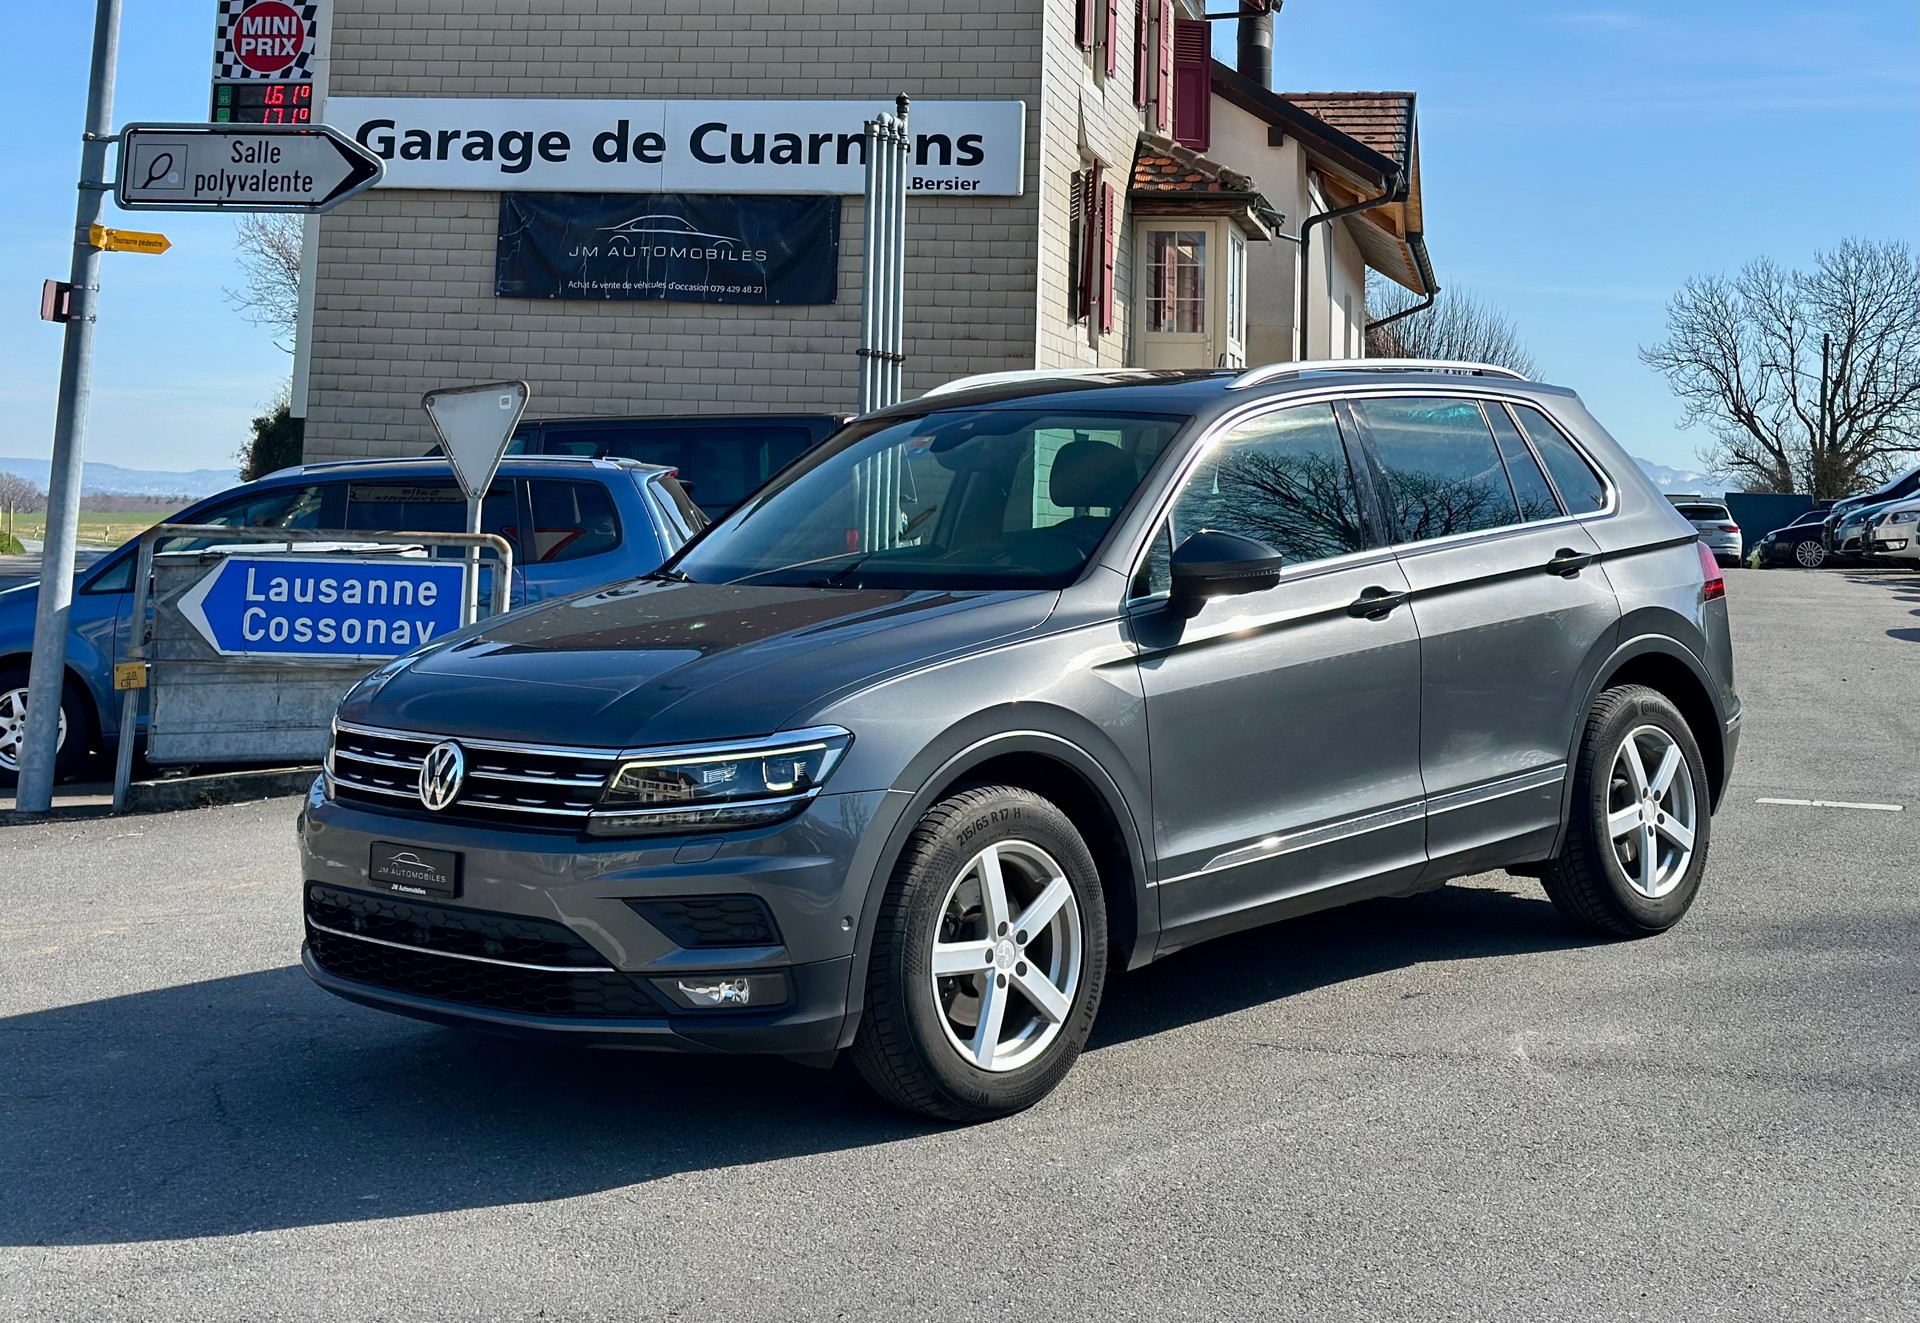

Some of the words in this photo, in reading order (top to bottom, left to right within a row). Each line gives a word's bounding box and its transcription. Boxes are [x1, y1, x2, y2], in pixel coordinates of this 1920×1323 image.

[241, 16, 298, 36] MINI
[240, 37, 297, 57] PRIX
[230, 139, 281, 164] Salle
[354, 118, 571, 175] Garage
[591, 118, 667, 164] de
[688, 119, 985, 167] Cuarnns
[193, 168, 313, 198] polyvalente
[568, 246, 598, 258] JM
[607, 246, 767, 262] AUTOMOBILES
[567, 280, 590, 290] Achat
[591, 280, 599, 289] &
[599, 281, 621, 290] vente
[622, 280, 632, 290] de
[633, 280, 667, 290] véhicules
[668, 282, 709, 292] d'occasion
[710, 284, 725, 294] 079
[726, 285, 741, 294] 429
[742, 285, 752, 294] 48
[753, 286, 763, 294] 27
[245, 567, 438, 607] Lausanne
[242, 606, 436, 645] Cossonay
[957, 815, 989, 847] 215/65
[990, 811, 999, 824] R
[999, 807, 1009, 821] 17
[1013, 807, 1021, 819] H
[378, 866, 389, 874] JM
[390, 868, 446, 883] AUTOMOBILES
